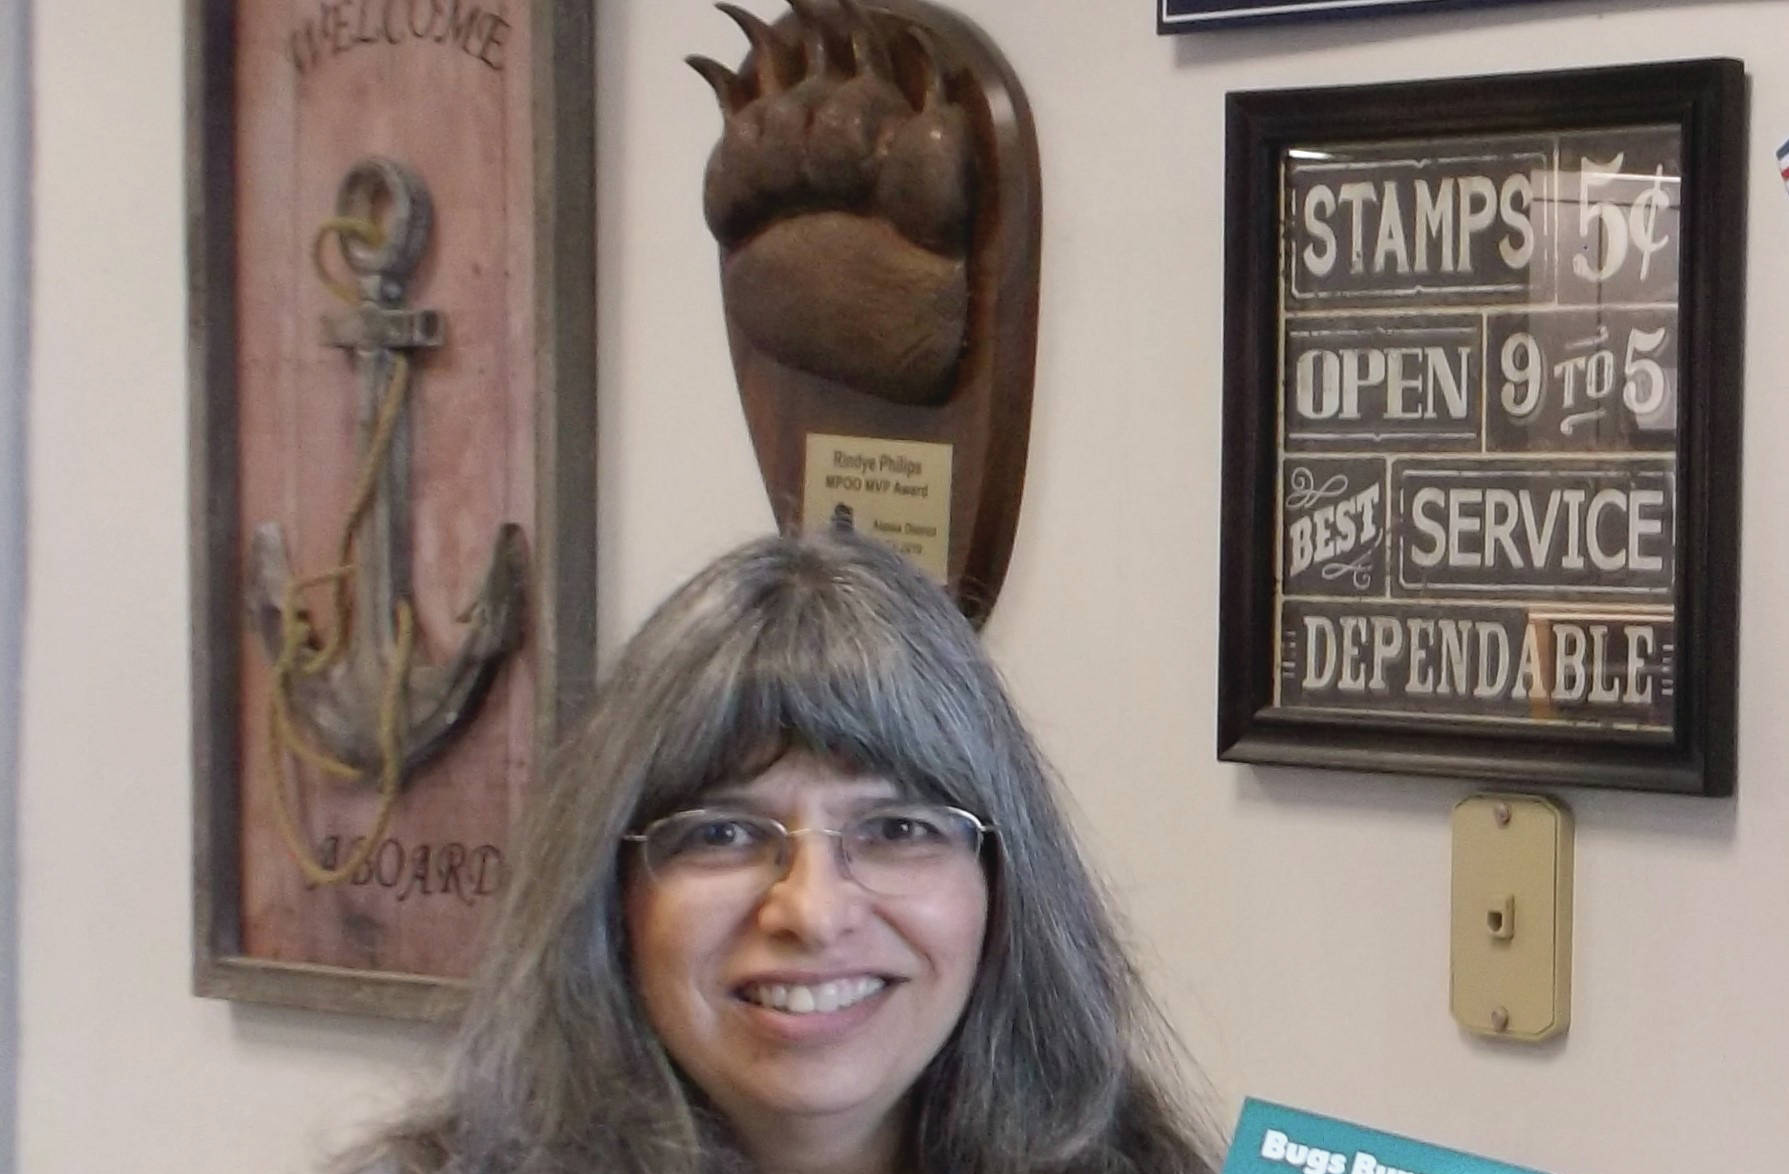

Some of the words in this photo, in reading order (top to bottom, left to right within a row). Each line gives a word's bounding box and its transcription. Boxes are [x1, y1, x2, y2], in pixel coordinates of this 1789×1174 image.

[1303, 172, 1536, 277] STAMPS
[1572, 151, 1671, 282] 5¢
[1295, 345, 1471, 421] OPEN
[1500, 331, 1544, 418] 9
[1622, 326, 1667, 415] 5
[1289, 482, 1383, 577] BEST
[1411, 487, 1663, 571] SERVICE
[1301, 614, 1655, 704] DEPENDABLE
